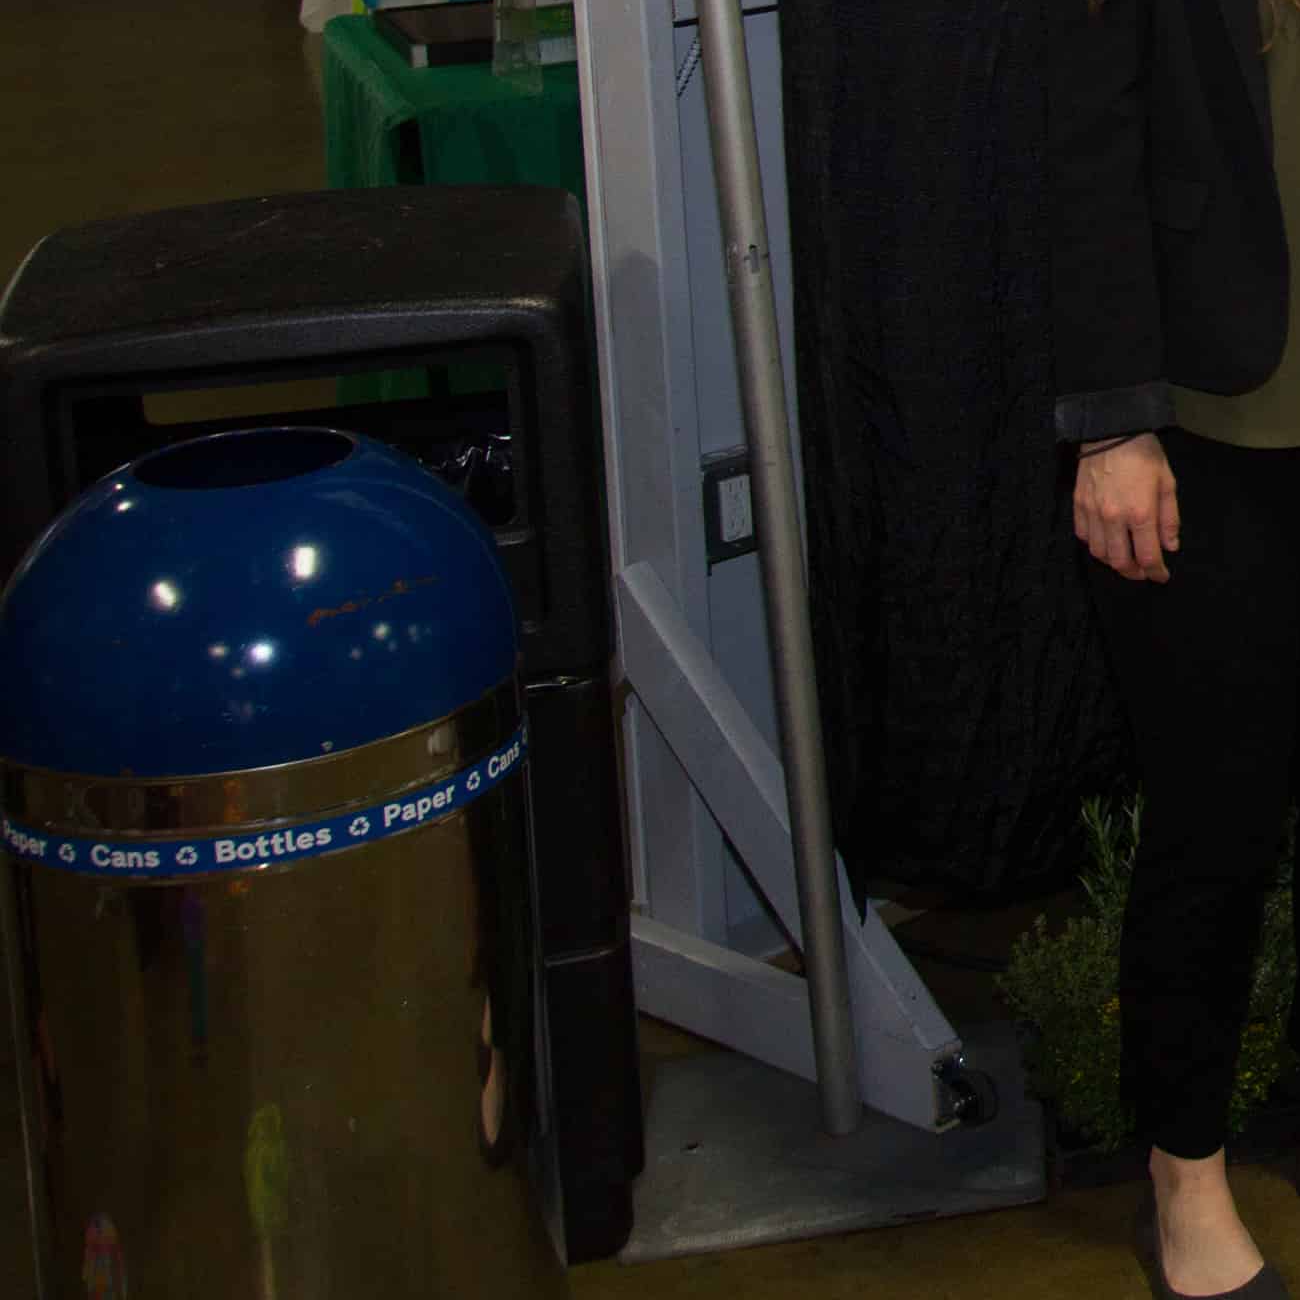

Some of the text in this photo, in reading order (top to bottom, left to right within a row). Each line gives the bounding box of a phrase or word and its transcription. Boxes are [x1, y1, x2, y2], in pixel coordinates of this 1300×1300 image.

[90, 843, 160, 869] Cans
[214, 826, 332, 864] Bottles
[383, 784, 456, 829] Paper
[487, 737, 522, 780] Cans
